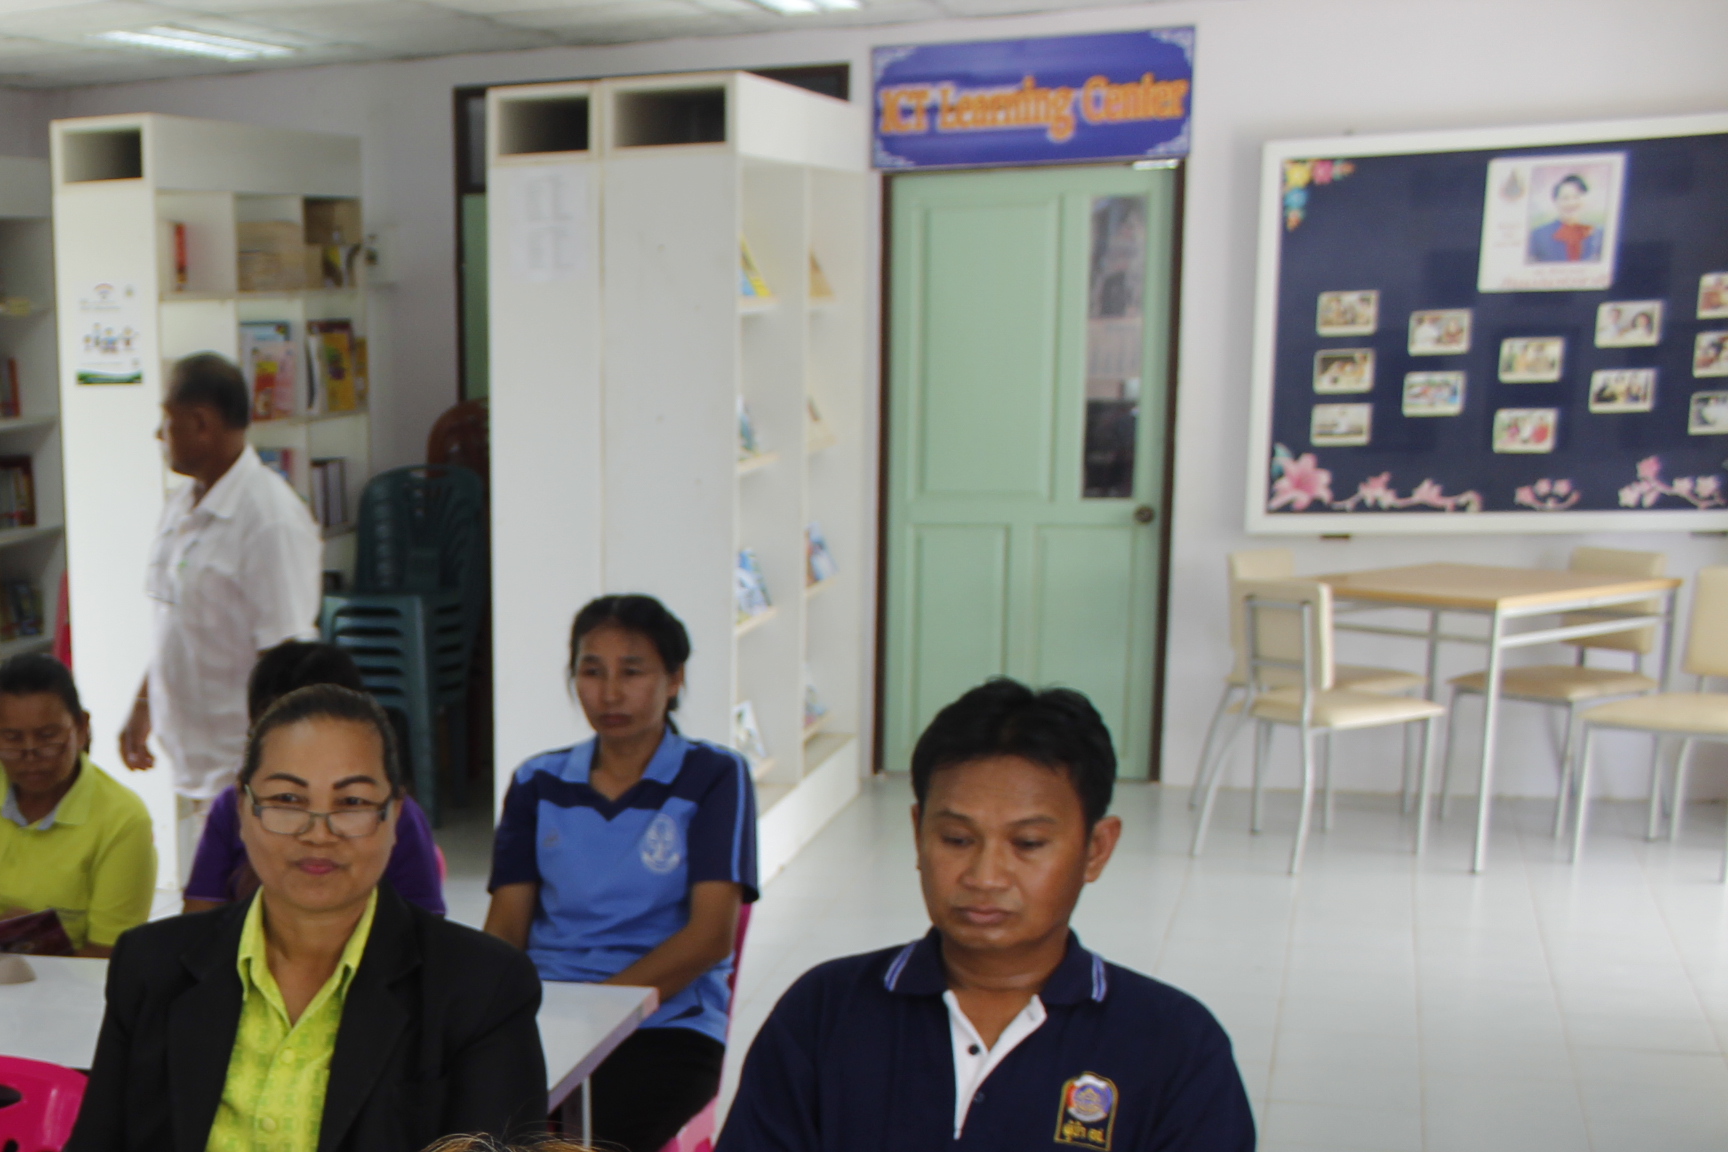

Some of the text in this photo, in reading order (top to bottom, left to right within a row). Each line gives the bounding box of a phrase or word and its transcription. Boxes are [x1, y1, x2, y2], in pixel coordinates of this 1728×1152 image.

[879, 73, 1189, 141] ICT Learning Center
